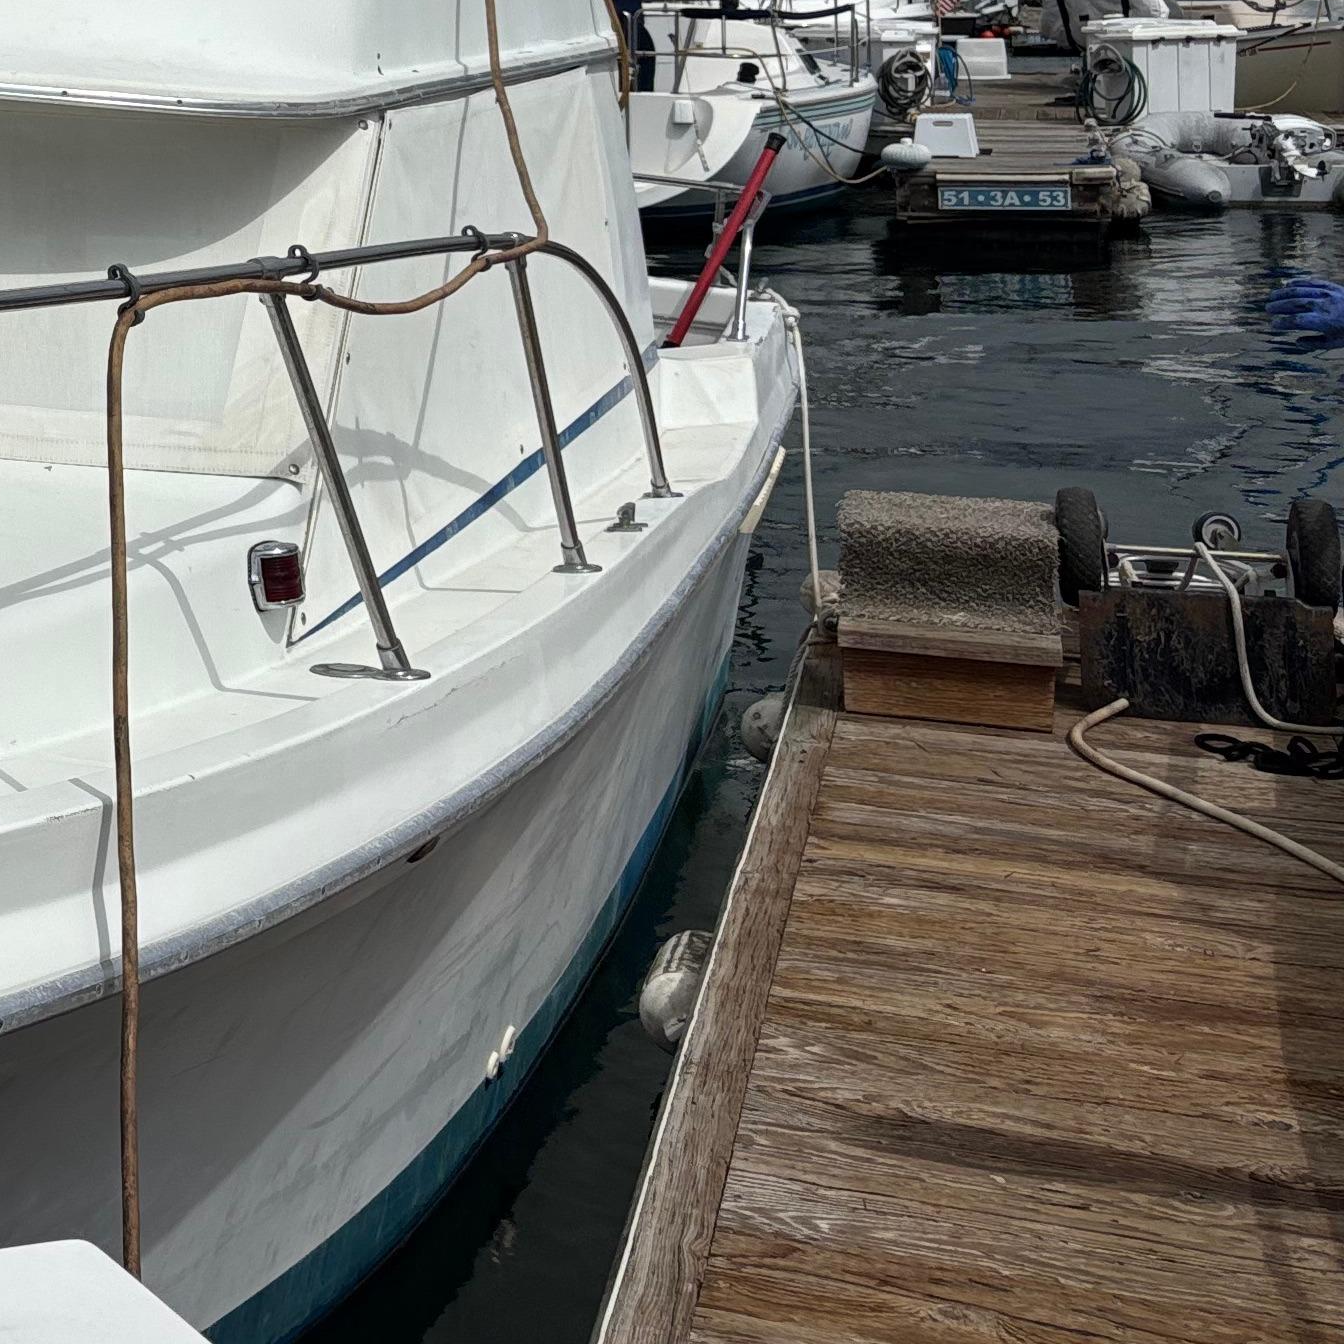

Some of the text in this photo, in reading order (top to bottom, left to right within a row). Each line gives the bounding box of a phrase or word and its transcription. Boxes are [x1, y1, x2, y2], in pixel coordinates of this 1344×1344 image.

[943, 190, 1066, 206] 51 3A 53
